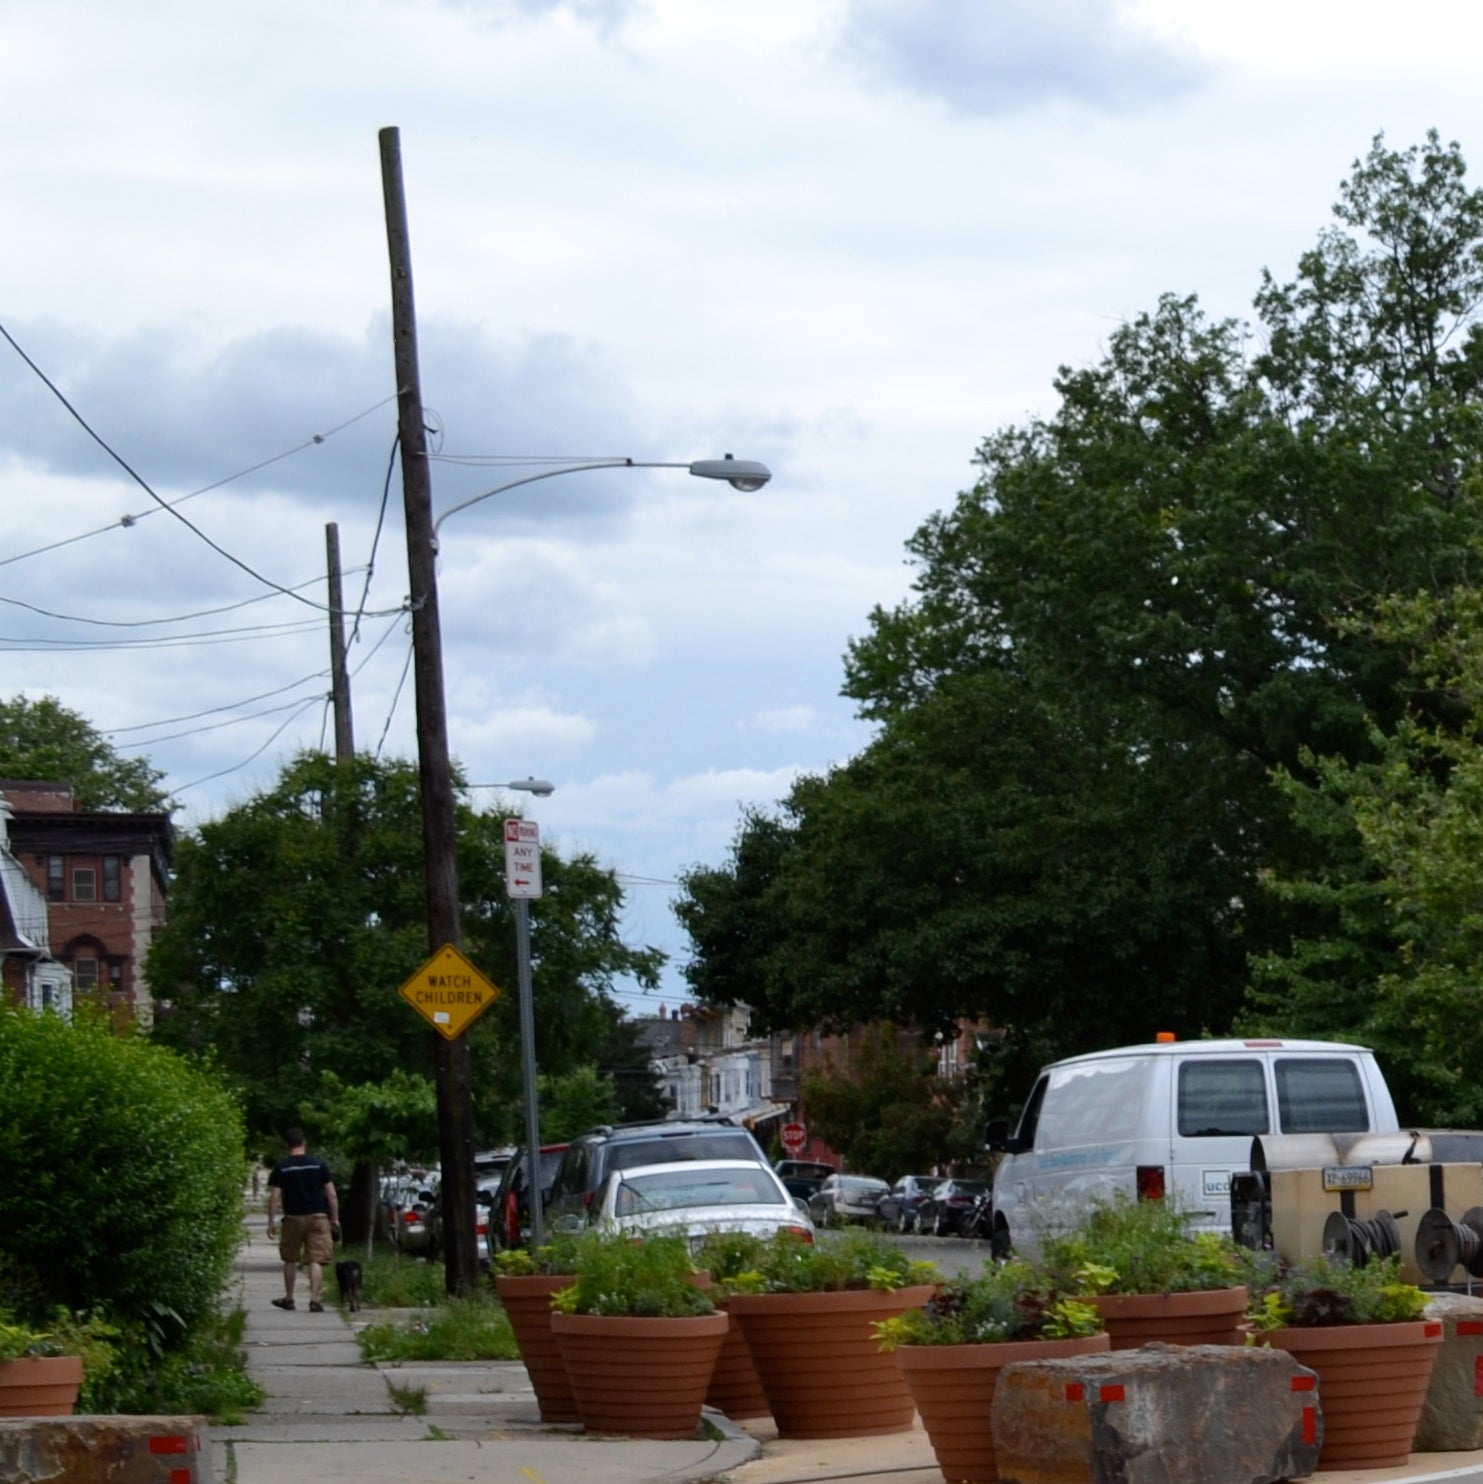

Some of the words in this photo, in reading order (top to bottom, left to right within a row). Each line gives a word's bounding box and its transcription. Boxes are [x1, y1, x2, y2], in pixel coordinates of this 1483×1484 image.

[514, 847, 533, 858] ANY
[514, 862, 534, 873] TIME
[428, 975, 472, 988] WATCH
[415, 991, 483, 1005] CHILDREN
[782, 1130, 805, 1140] STOP
